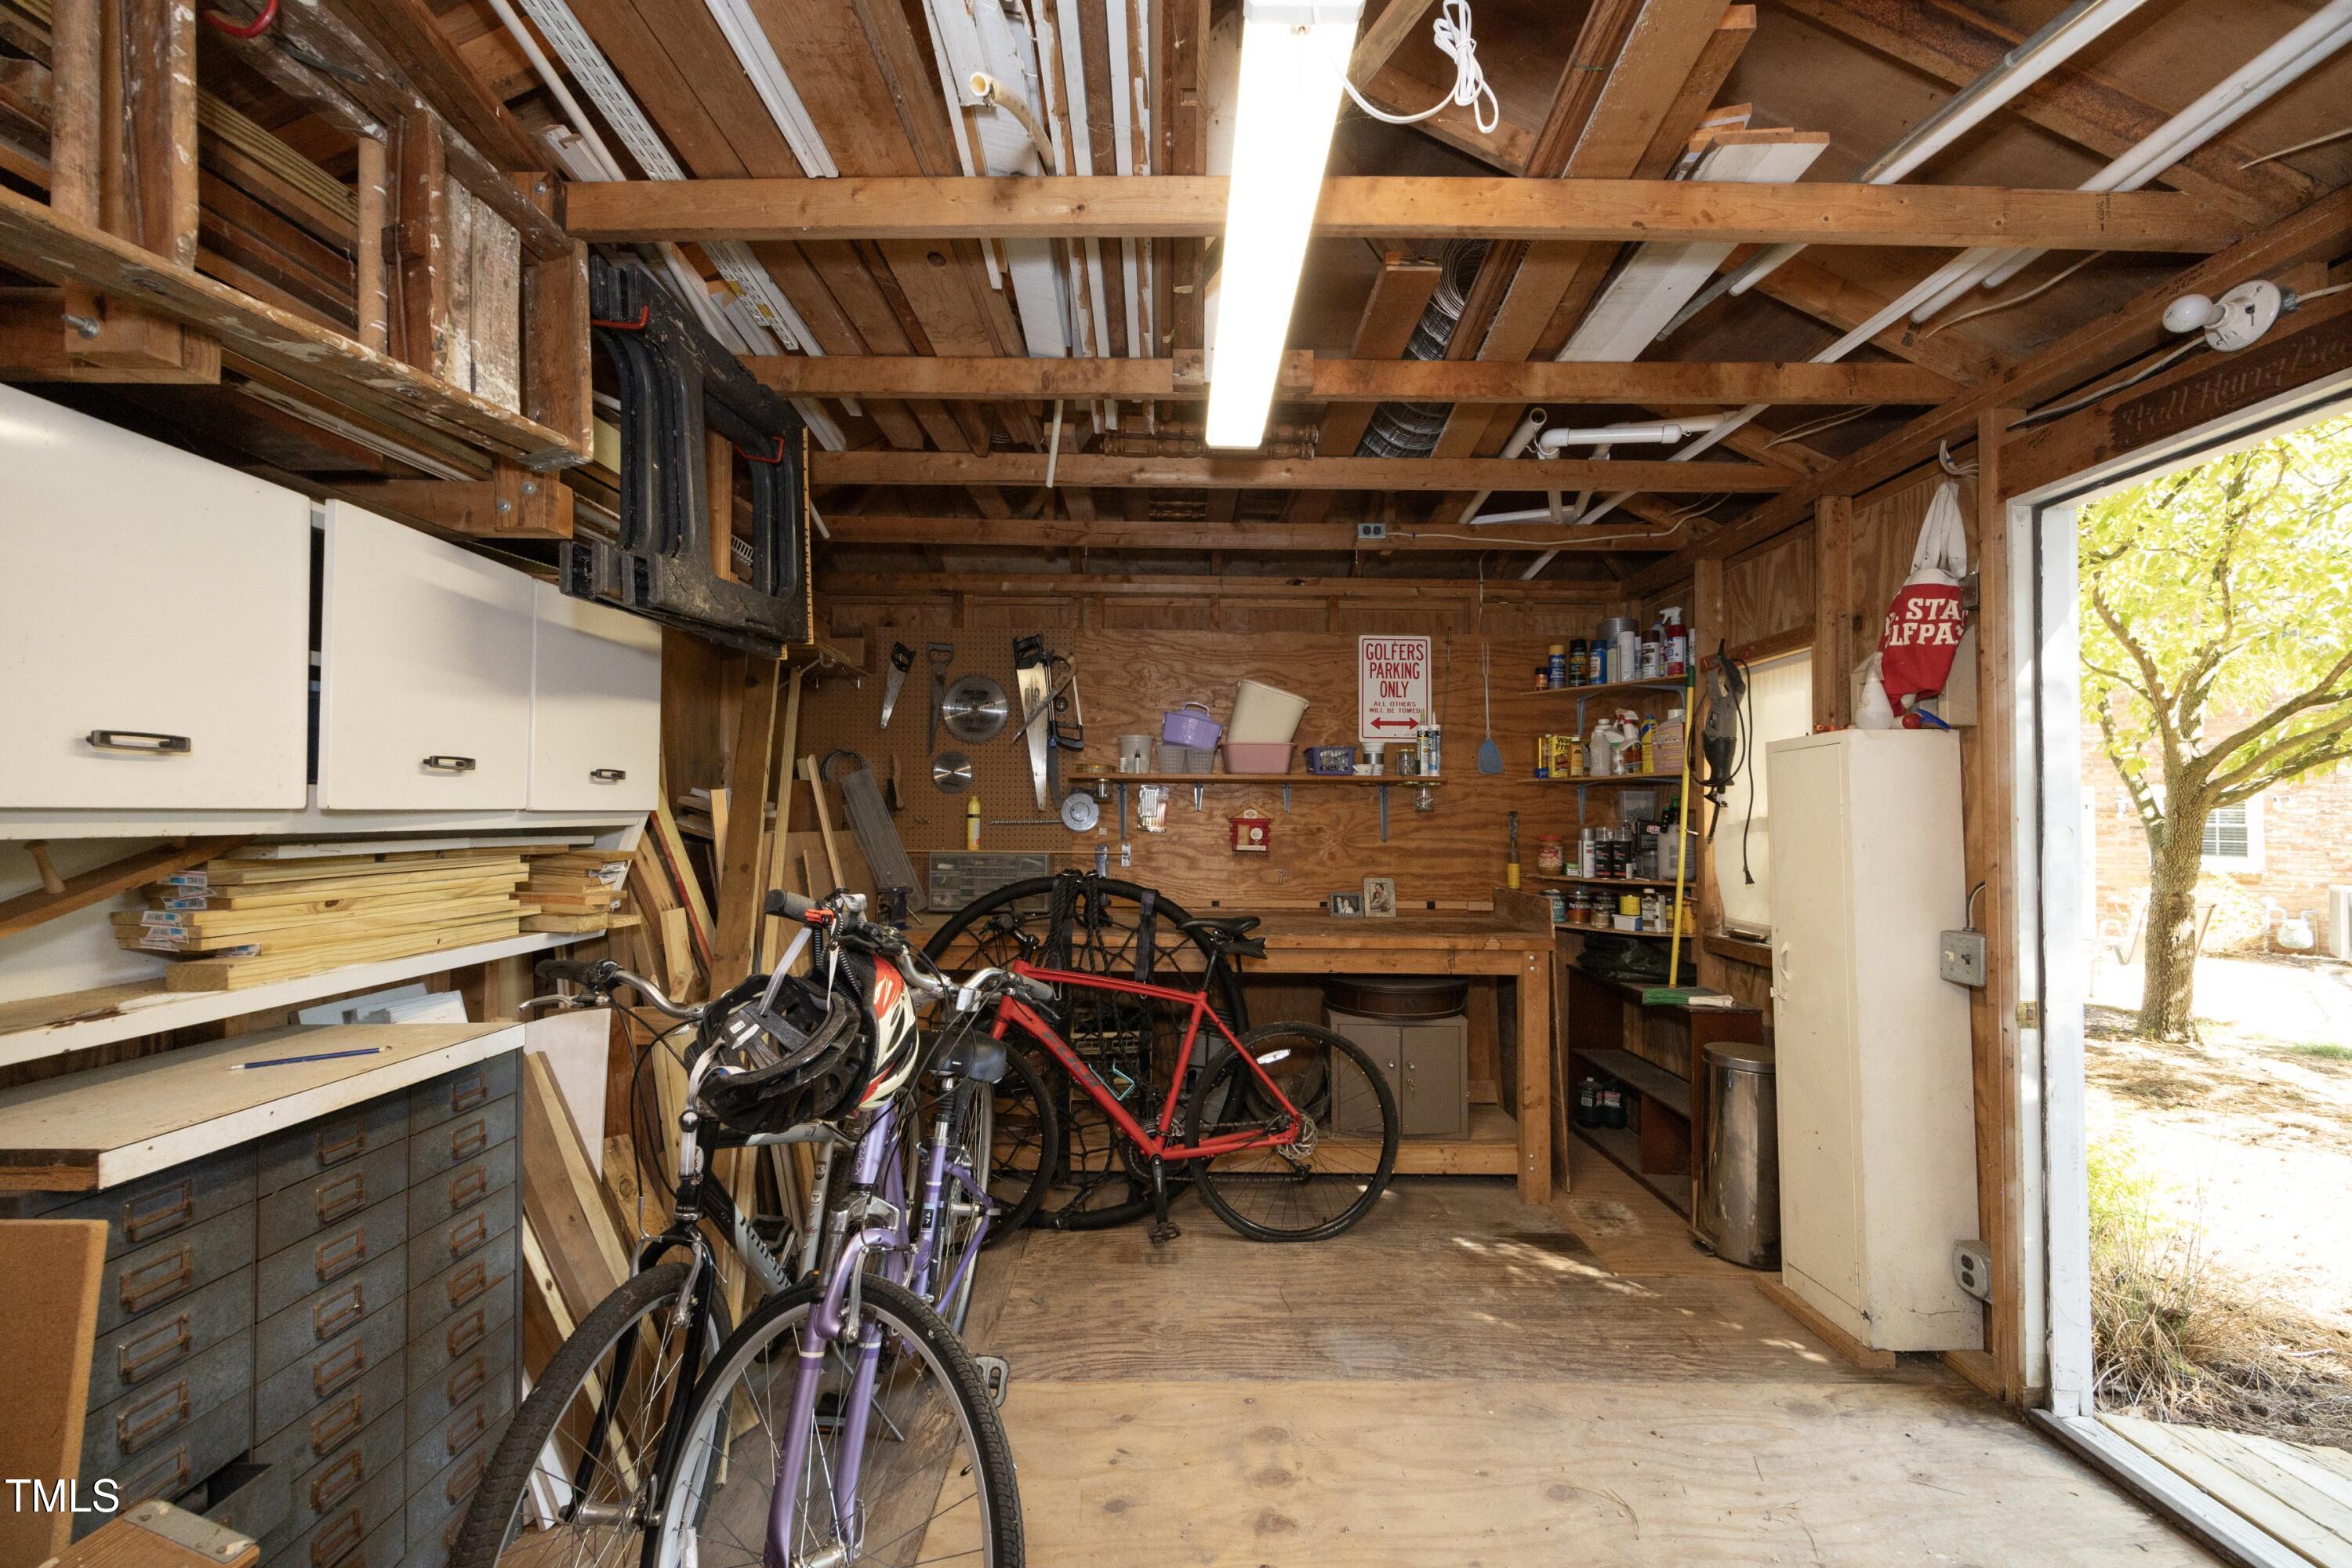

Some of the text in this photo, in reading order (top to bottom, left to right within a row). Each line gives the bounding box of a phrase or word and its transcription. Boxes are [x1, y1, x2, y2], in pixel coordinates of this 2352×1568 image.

[1885, 622, 1964, 648] LFPA
[1366, 643, 1424, 661] GOLFERS
[1370, 662, 1420, 680] PARKING
[1380, 681, 1409, 698] ONLY
